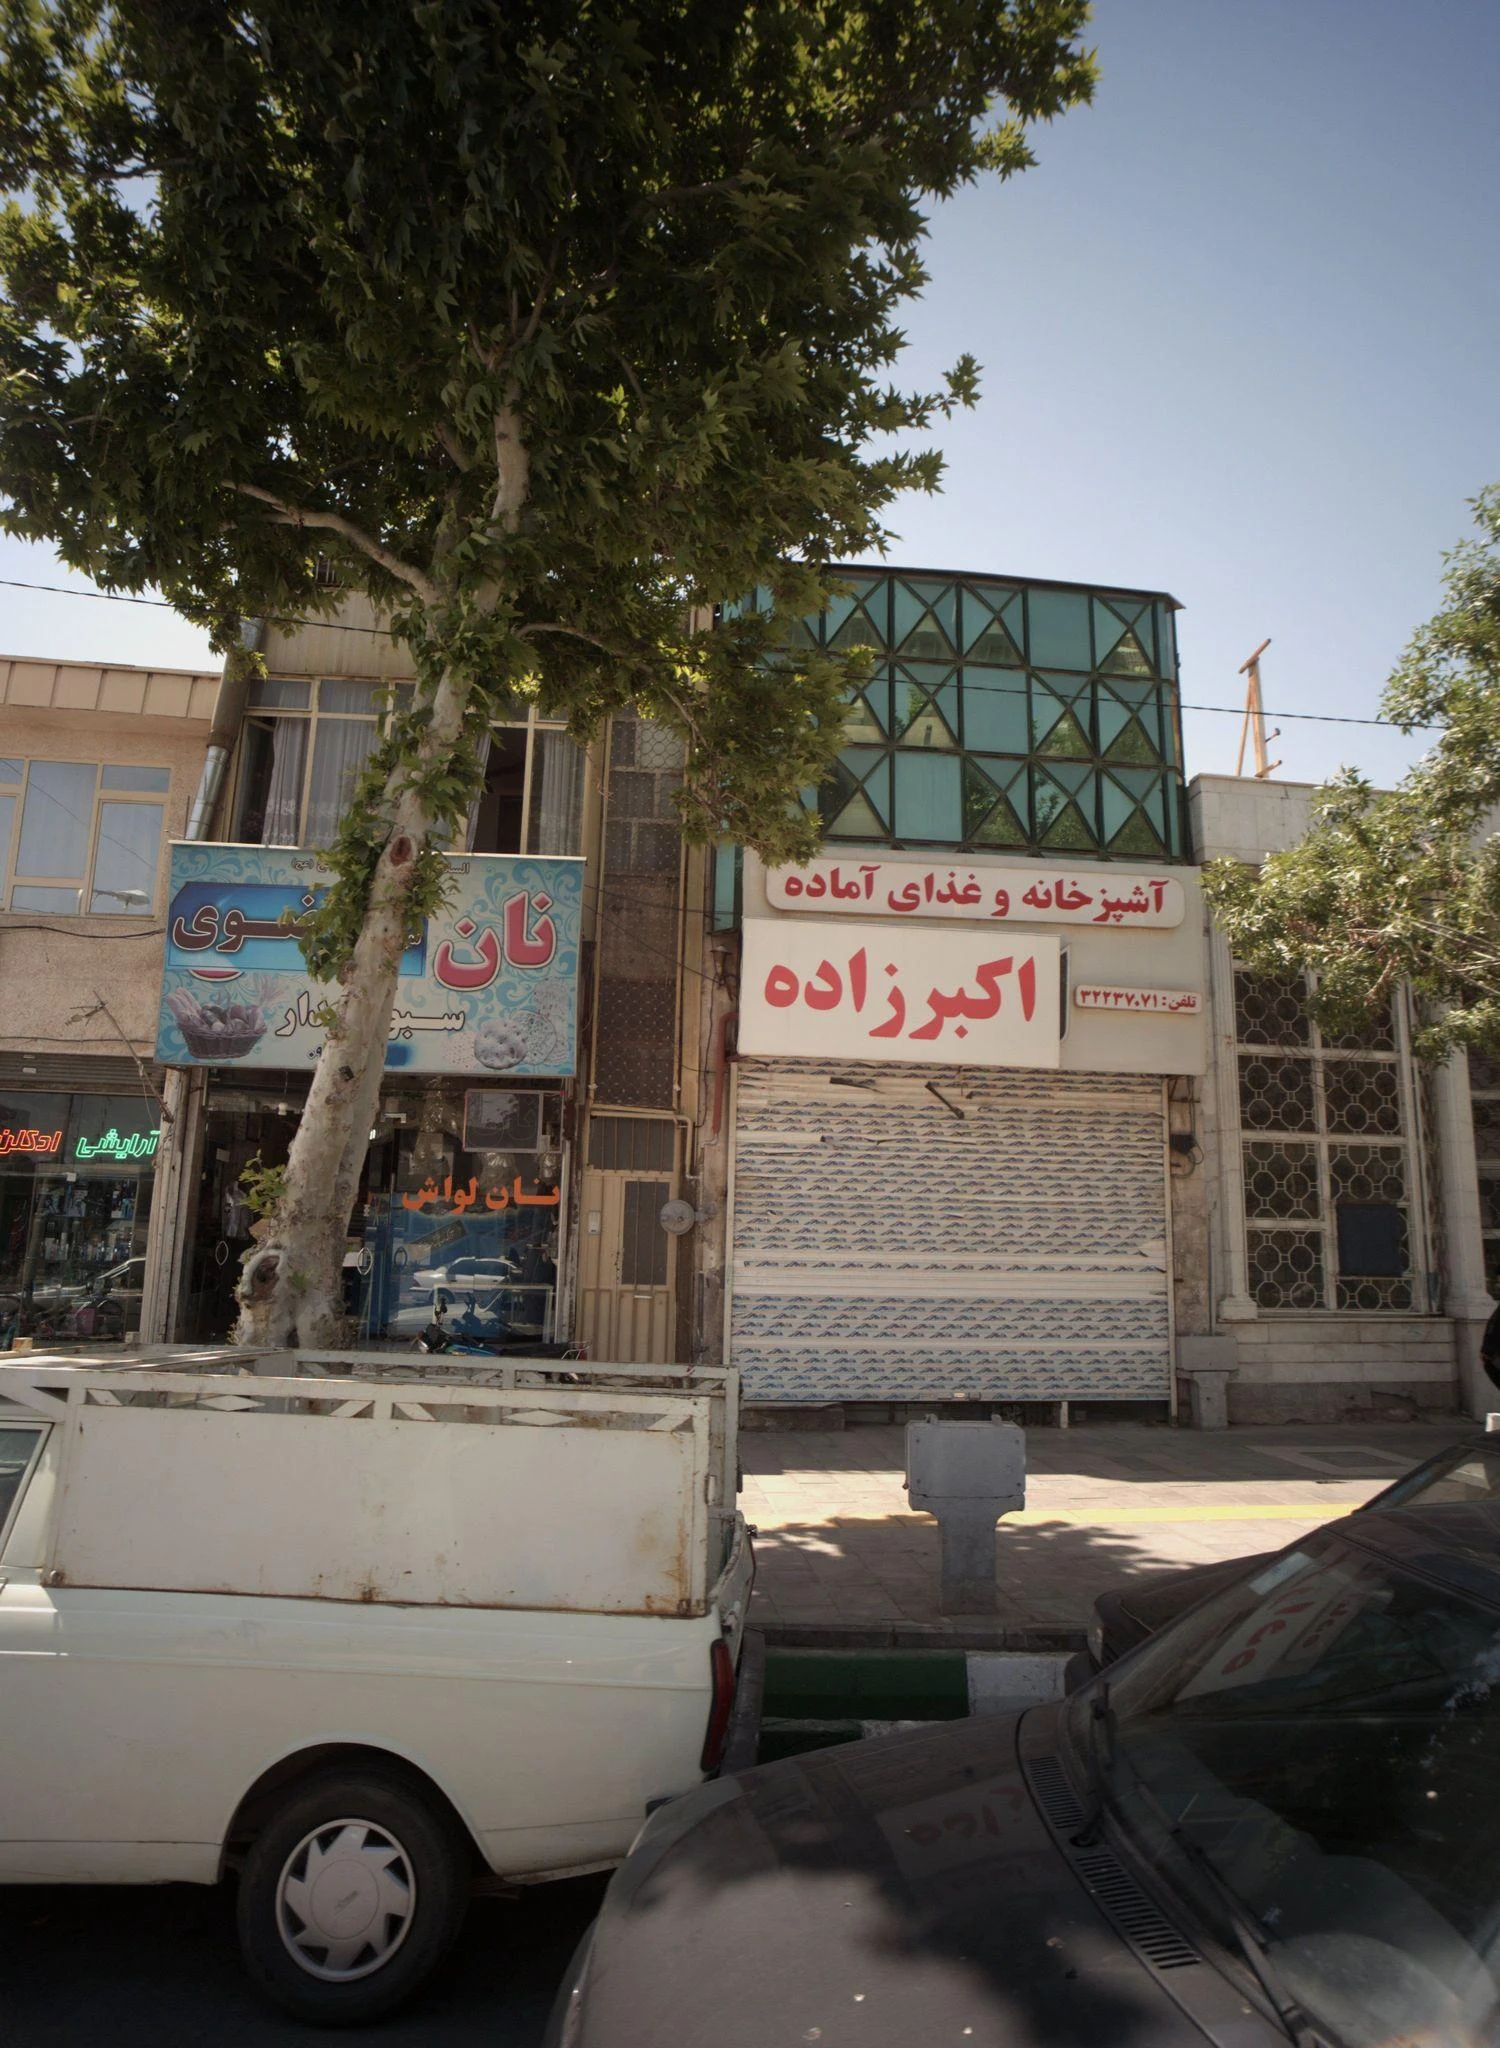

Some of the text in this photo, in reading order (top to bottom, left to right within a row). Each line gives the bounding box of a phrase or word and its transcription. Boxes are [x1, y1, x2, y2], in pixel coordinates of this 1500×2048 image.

[784, 864, 1170, 922] آشپزخانه و غذای آماده
[172, 894, 324, 953] ضوی
[433, 890, 557, 992] نان
[75, 1128, 161, 1160] آرایشی
[402, 1175, 561, 1215] نان لواش
